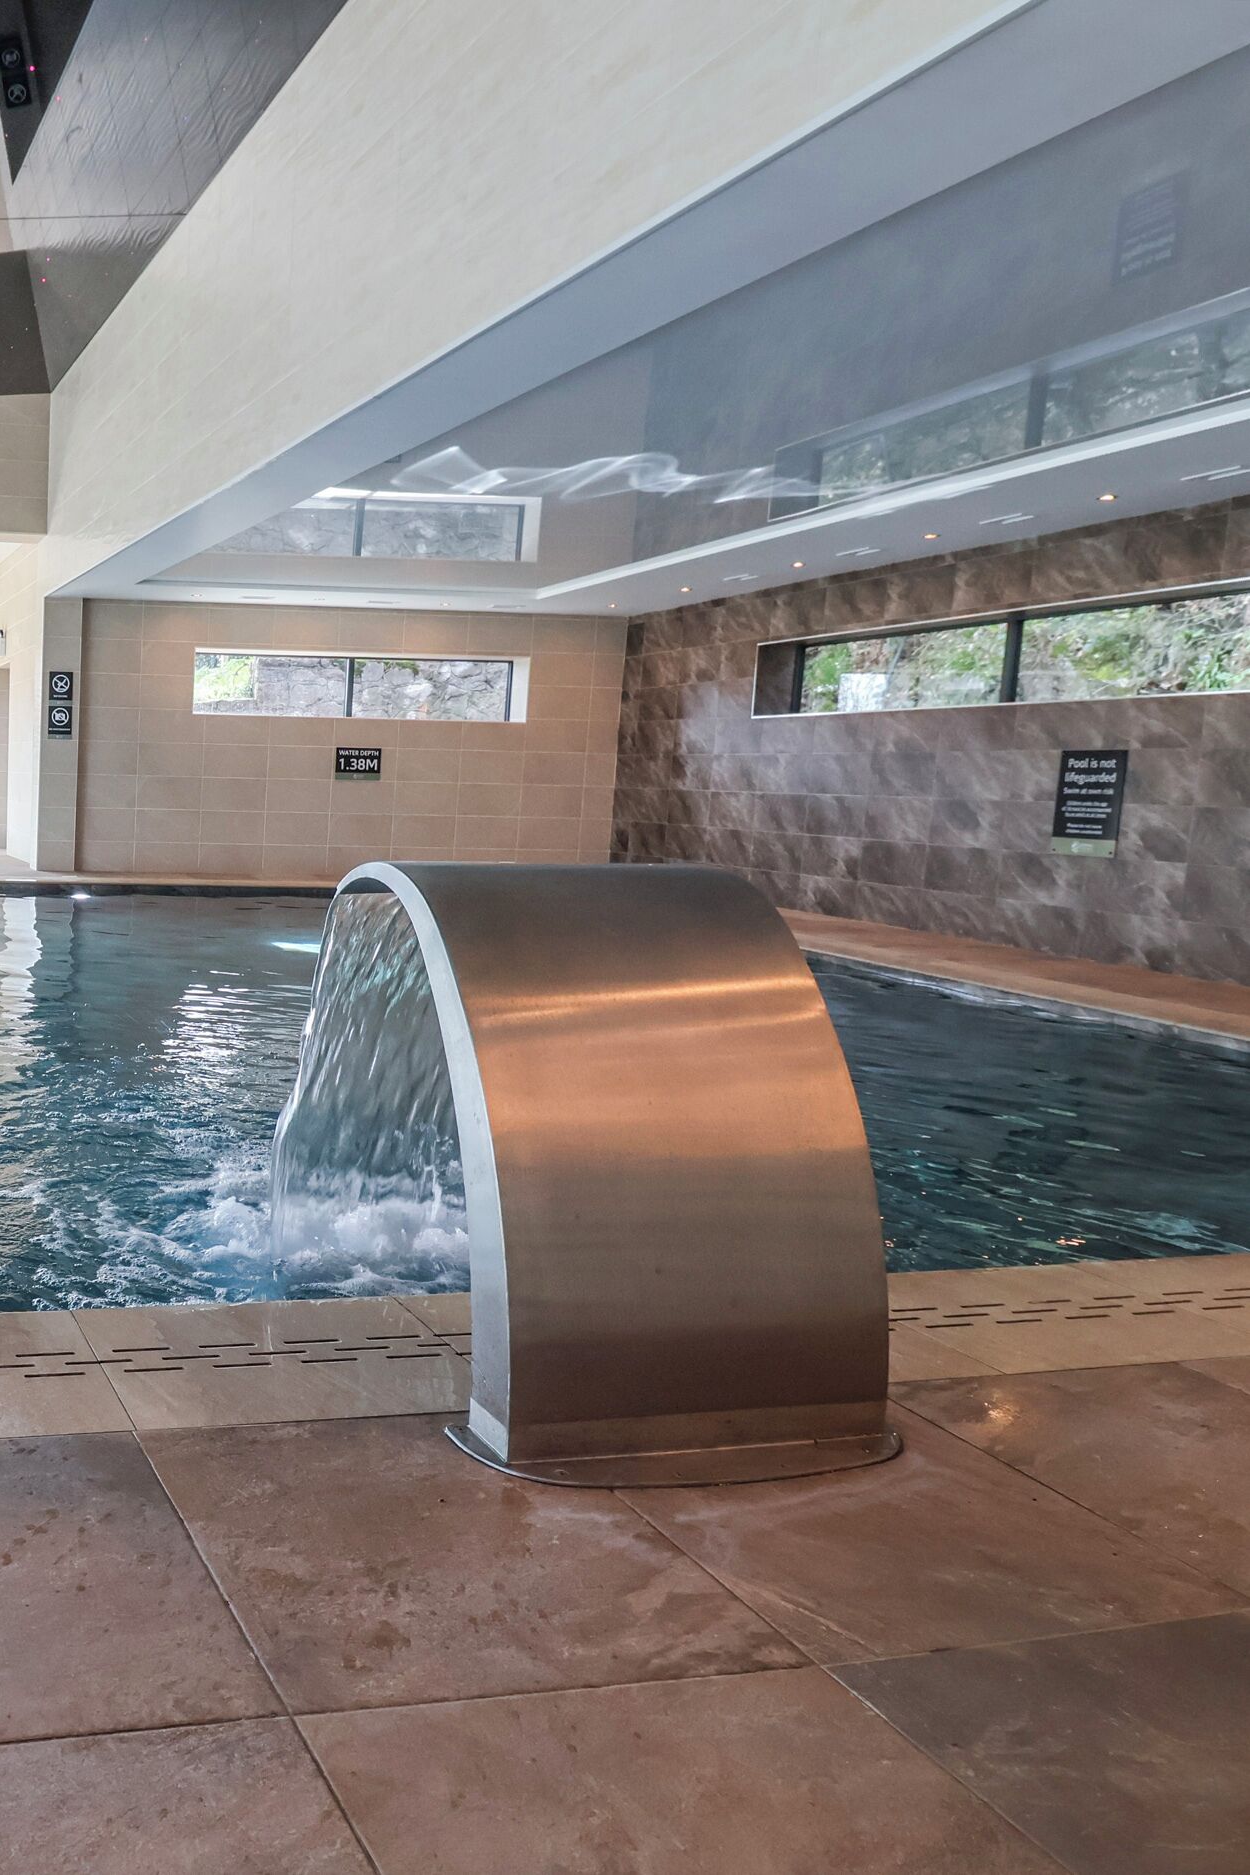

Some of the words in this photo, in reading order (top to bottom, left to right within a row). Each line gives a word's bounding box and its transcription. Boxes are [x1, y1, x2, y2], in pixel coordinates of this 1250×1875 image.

[339, 758, 378, 770] 1.38M
[1067, 758, 1089, 768] Pool
[1090, 758, 1098, 768] is
[1099, 759, 1117, 768] not
[1064, 771, 1117, 785] lifeguarded
[1063, 786, 1080, 794] Swim
